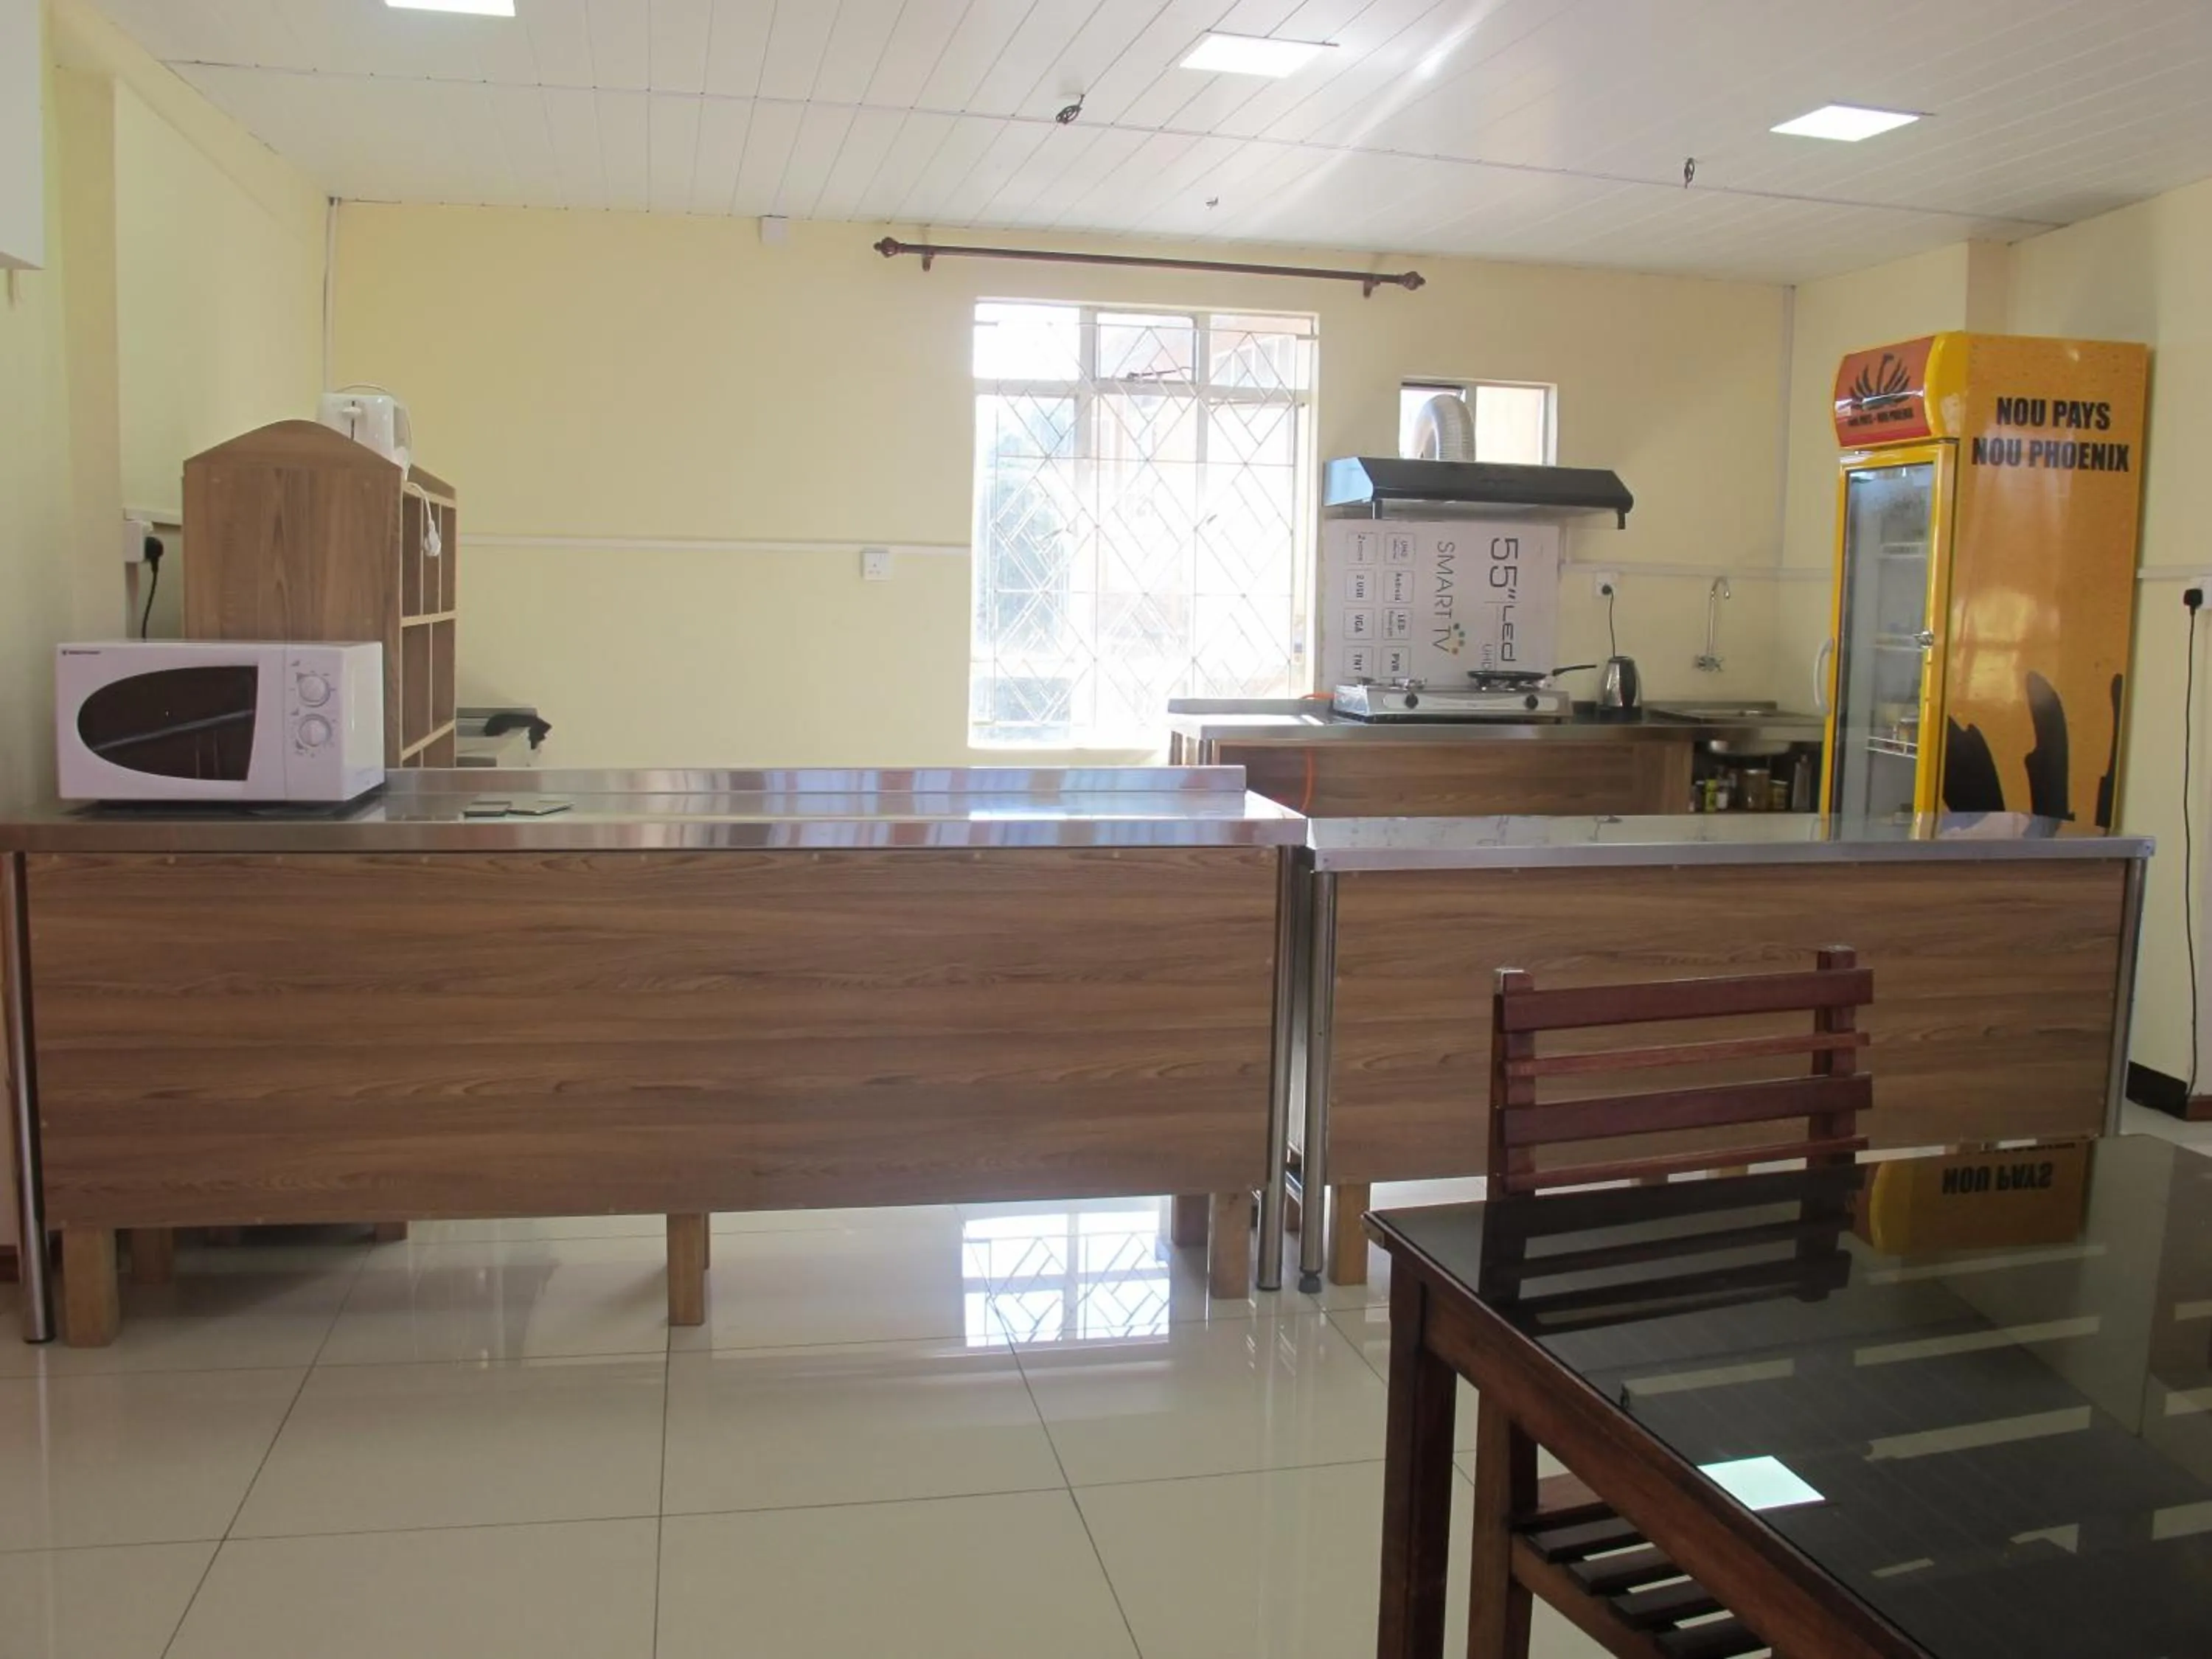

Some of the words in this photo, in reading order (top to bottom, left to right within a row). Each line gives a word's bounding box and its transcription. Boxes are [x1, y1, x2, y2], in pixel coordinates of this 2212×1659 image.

[1997, 397, 2046, 426] NOU
[2053, 400, 2112, 431] PAYS
[1972, 439, 2024, 467] NOU
[2030, 441, 2129, 473] PHOENIX
[1434, 540, 1455, 619] SMART
[1354, 613, 1364, 633] VGA
[1432, 625, 1452, 653] TV
